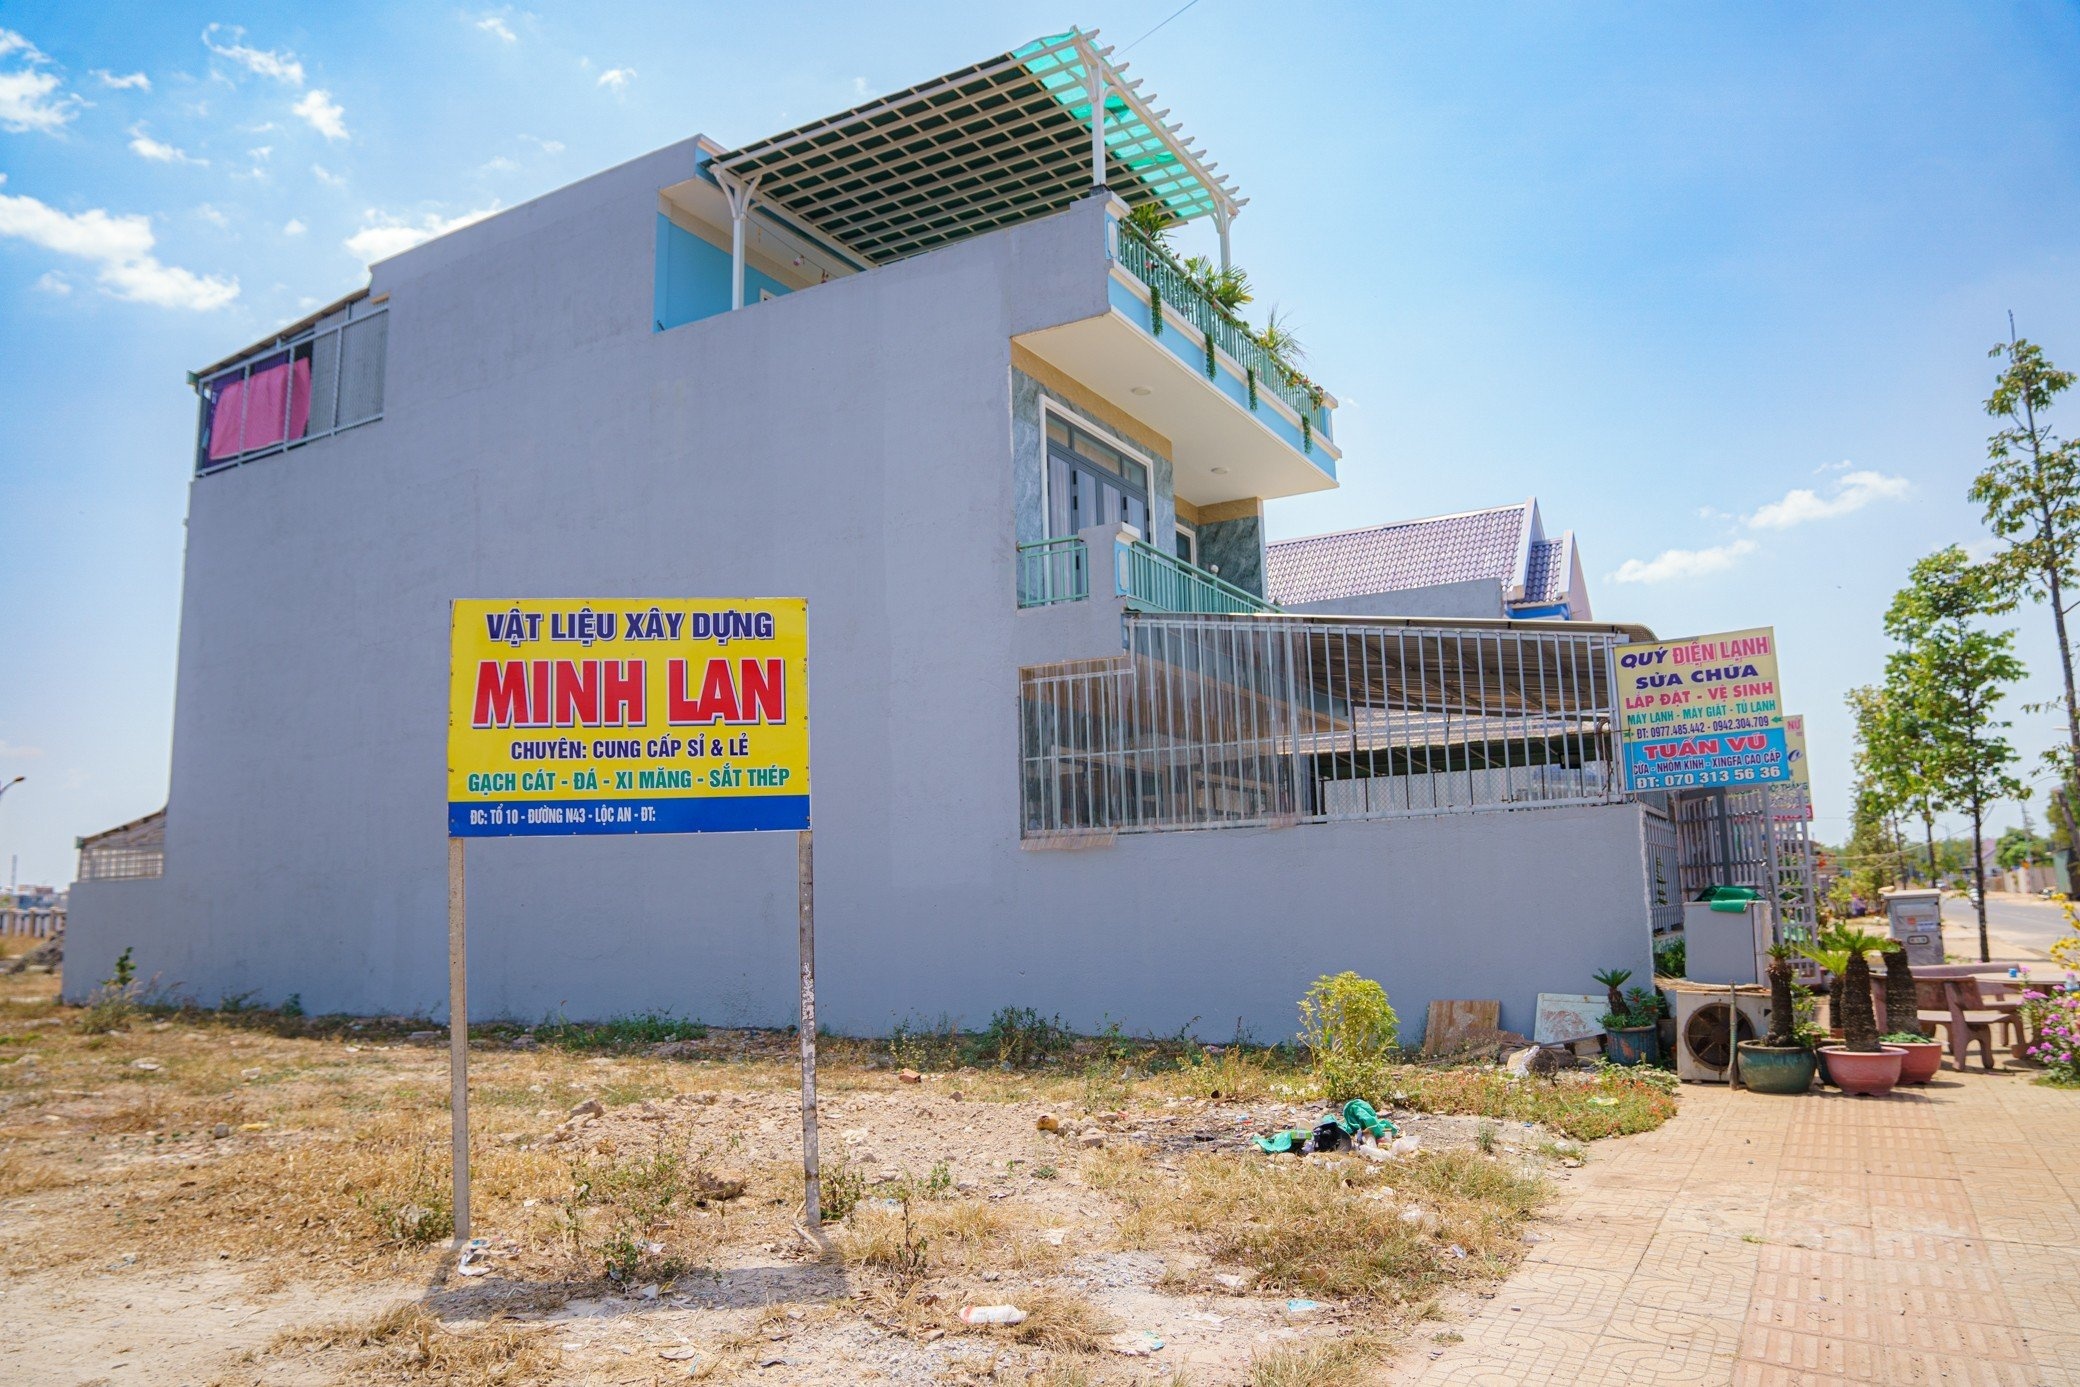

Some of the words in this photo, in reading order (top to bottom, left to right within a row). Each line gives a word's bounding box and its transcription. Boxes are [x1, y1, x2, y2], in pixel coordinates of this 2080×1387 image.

[486, 608, 542, 646] VẬT
[551, 608, 618, 646] LIỆU
[624, 607, 686, 640] XÂY
[692, 610, 775, 646] DỰNG
[1620, 646, 1668, 669] QUÝ
[1672, 642, 1716, 667] ĐIỆN
[1720, 636, 1770, 662] LẠNH
[1636, 672, 1683, 689] SỬA
[1691, 664, 1759, 683] CHỮA
[471, 659, 646, 728] MINH
[667, 658, 786, 726] LAN
[1733, 682, 1773, 697] SINH
[1650, 710, 1674, 725] LẠNH
[1751, 700, 1776, 714] LẠNH
[1637, 729, 1648, 739] ĐT:
[1651, 723, 1705, 737] 0977.485.442
[1713, 716, 1769, 732] 0942.304.709
[510, 737, 587, 760] CHUYÊN:
[593, 740, 641, 758] CUNG
[647, 733, 682, 758] CẤP
[688, 733, 705, 757] SỈ
[711, 738, 723, 756] &
[729, 733, 749, 756] LẺ
[1644, 737, 1719, 760] TUẤN
[1712, 755, 1743, 768] XINGFA
[1745, 754, 1762, 764] CAO
[468, 772, 516, 795] GẠCH
[522, 769, 556, 792] CÁT
[573, 769, 598, 791] ĐÁ
[615, 771, 633, 790] XI
[639, 766, 692, 789] MĂNG
[709, 763, 743, 788] SẮT
[747, 765, 790, 787] THÉP
[1665, 773, 1695, 787] 070
[1699, 770, 1729, 783] 313
[1735, 768, 1754, 780] 56
[1760, 766, 1781, 778] 36
[470, 809, 488, 825] ĐC:
[490, 804, 503, 825] TỔ
[506, 809, 518, 824] 10
[528, 805, 563, 824] ĐƯỜNG
[566, 808, 586, 823] N43
[595, 805, 614, 826] LỘC
[617, 807, 632, 822] AN
[641, 806, 656, 822] ĐT:
